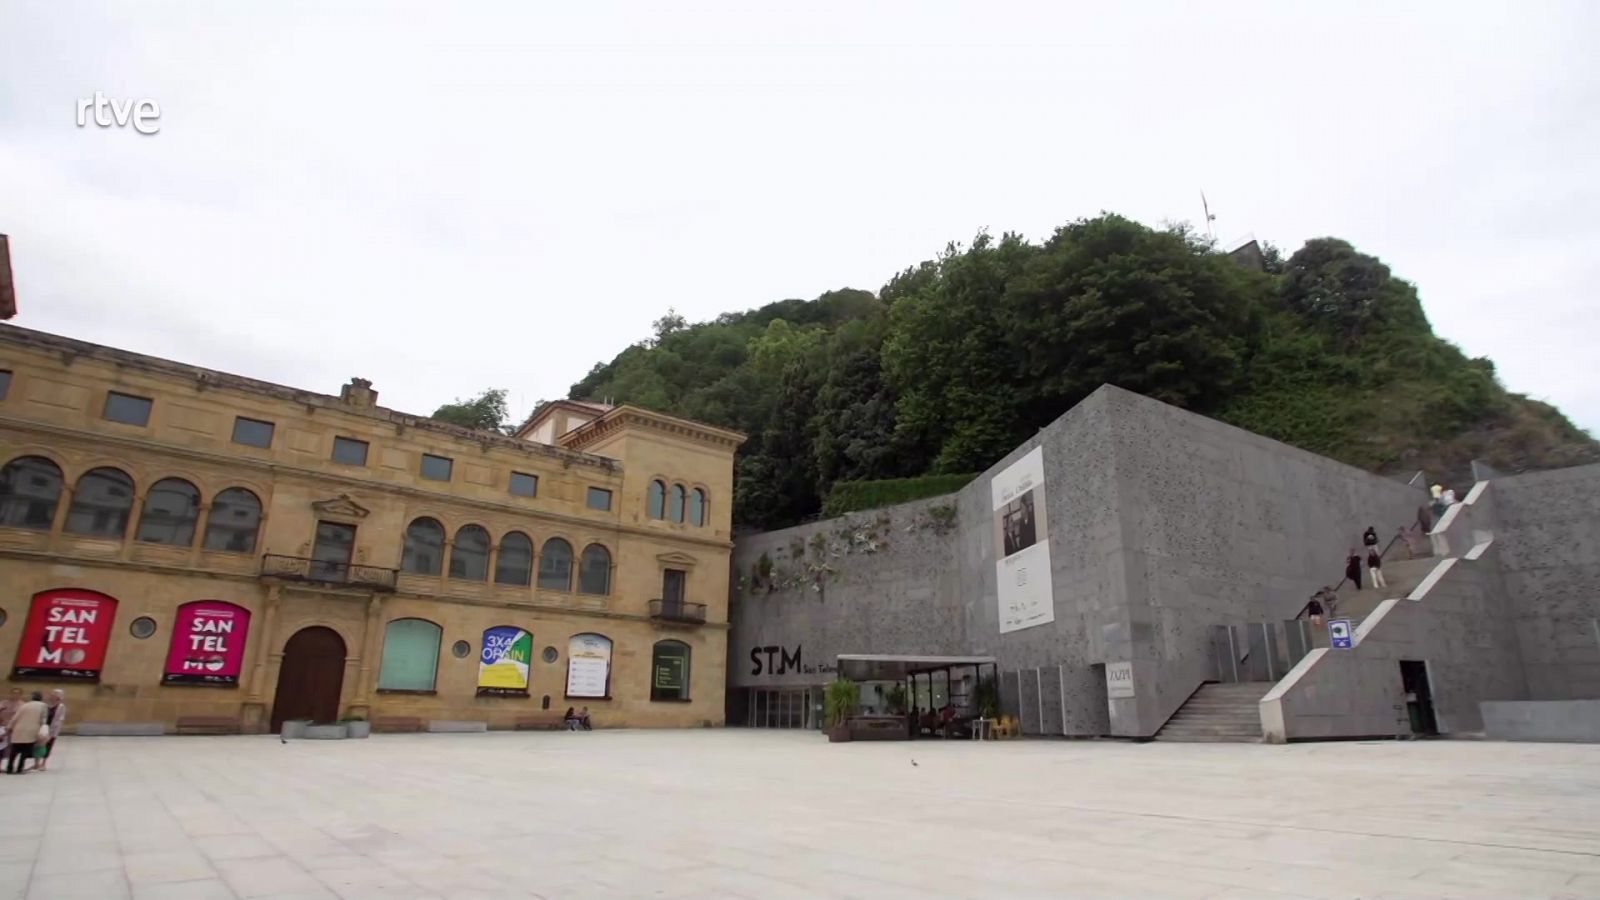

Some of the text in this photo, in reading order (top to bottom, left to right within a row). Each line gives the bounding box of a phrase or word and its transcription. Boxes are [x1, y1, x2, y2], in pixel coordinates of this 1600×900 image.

[48, 606, 97, 624] SAN
[191, 617, 233, 633] SAN
[45, 625, 90, 645] TEL
[189, 634, 228, 652] TEL
[750, 644, 802, 675] STM
